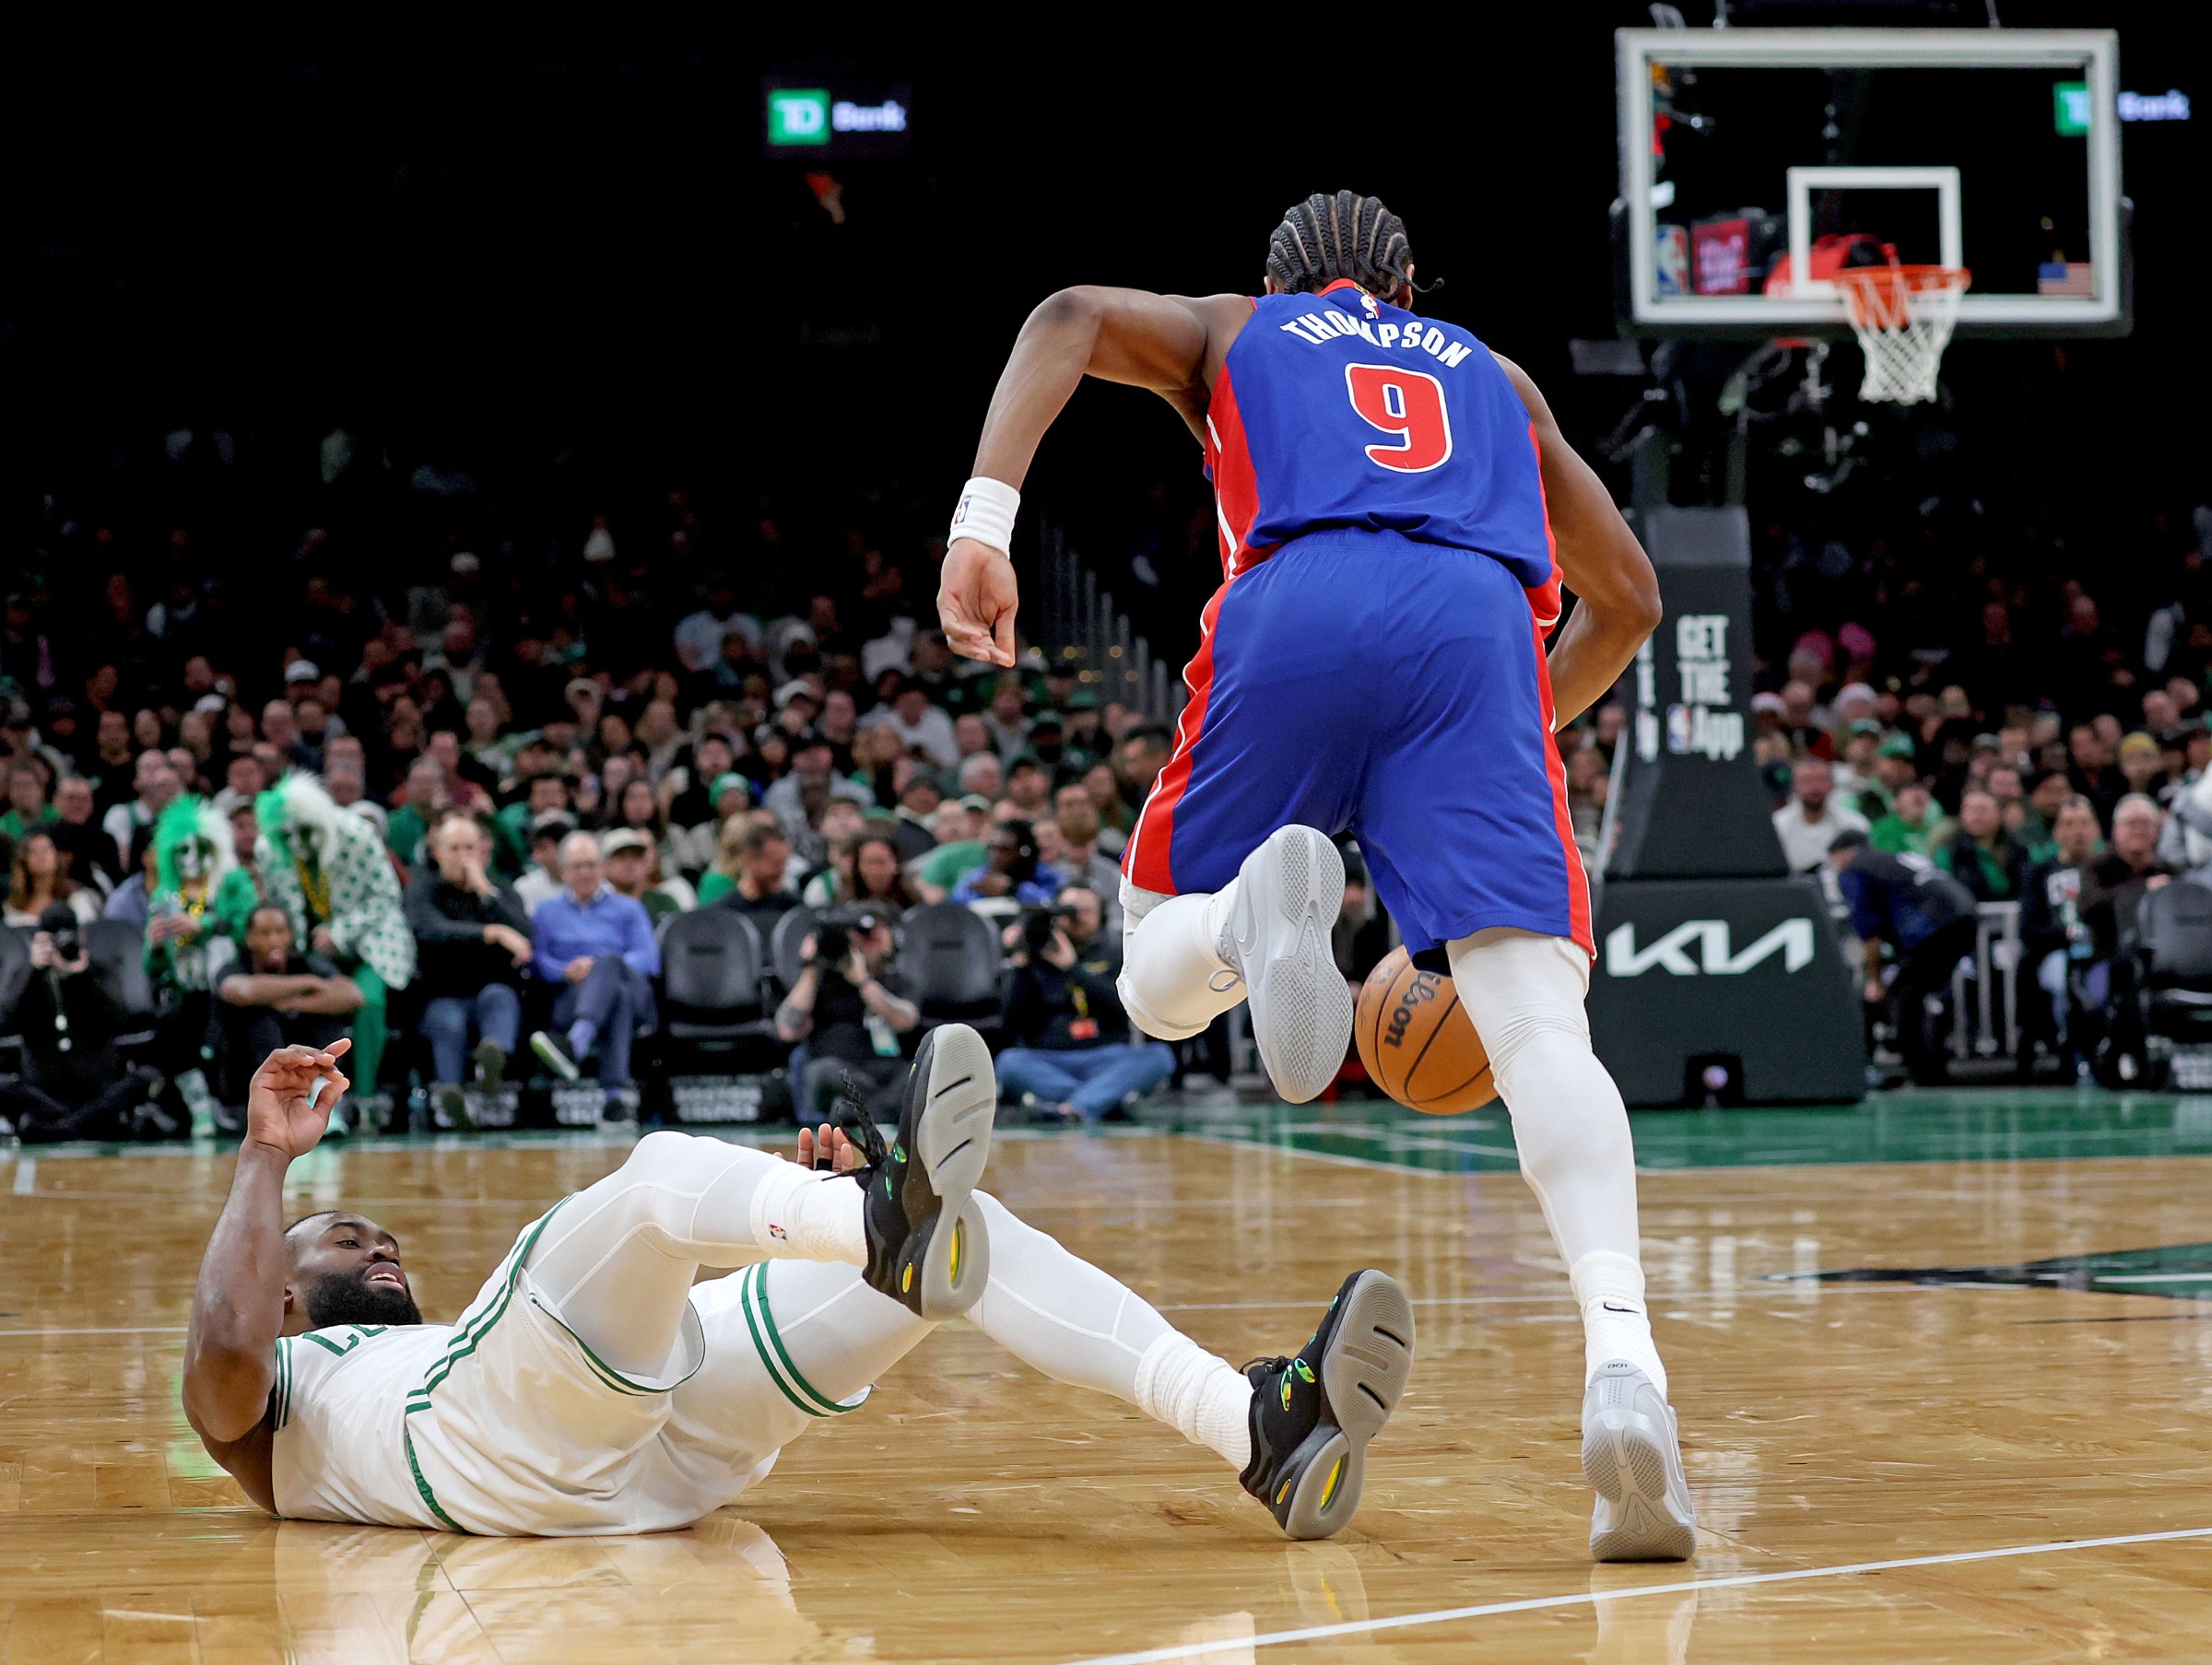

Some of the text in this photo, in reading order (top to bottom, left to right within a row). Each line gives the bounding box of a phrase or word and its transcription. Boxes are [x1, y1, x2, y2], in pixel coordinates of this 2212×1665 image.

[772, 99, 906, 135] TD Bank
[2117, 88, 2190, 121] Bank
[1279, 309, 1473, 369] THOMPSON
[1344, 362, 1453, 474] 9
[1677, 615, 1729, 658] GET
[1677, 659, 1732, 706] THE
